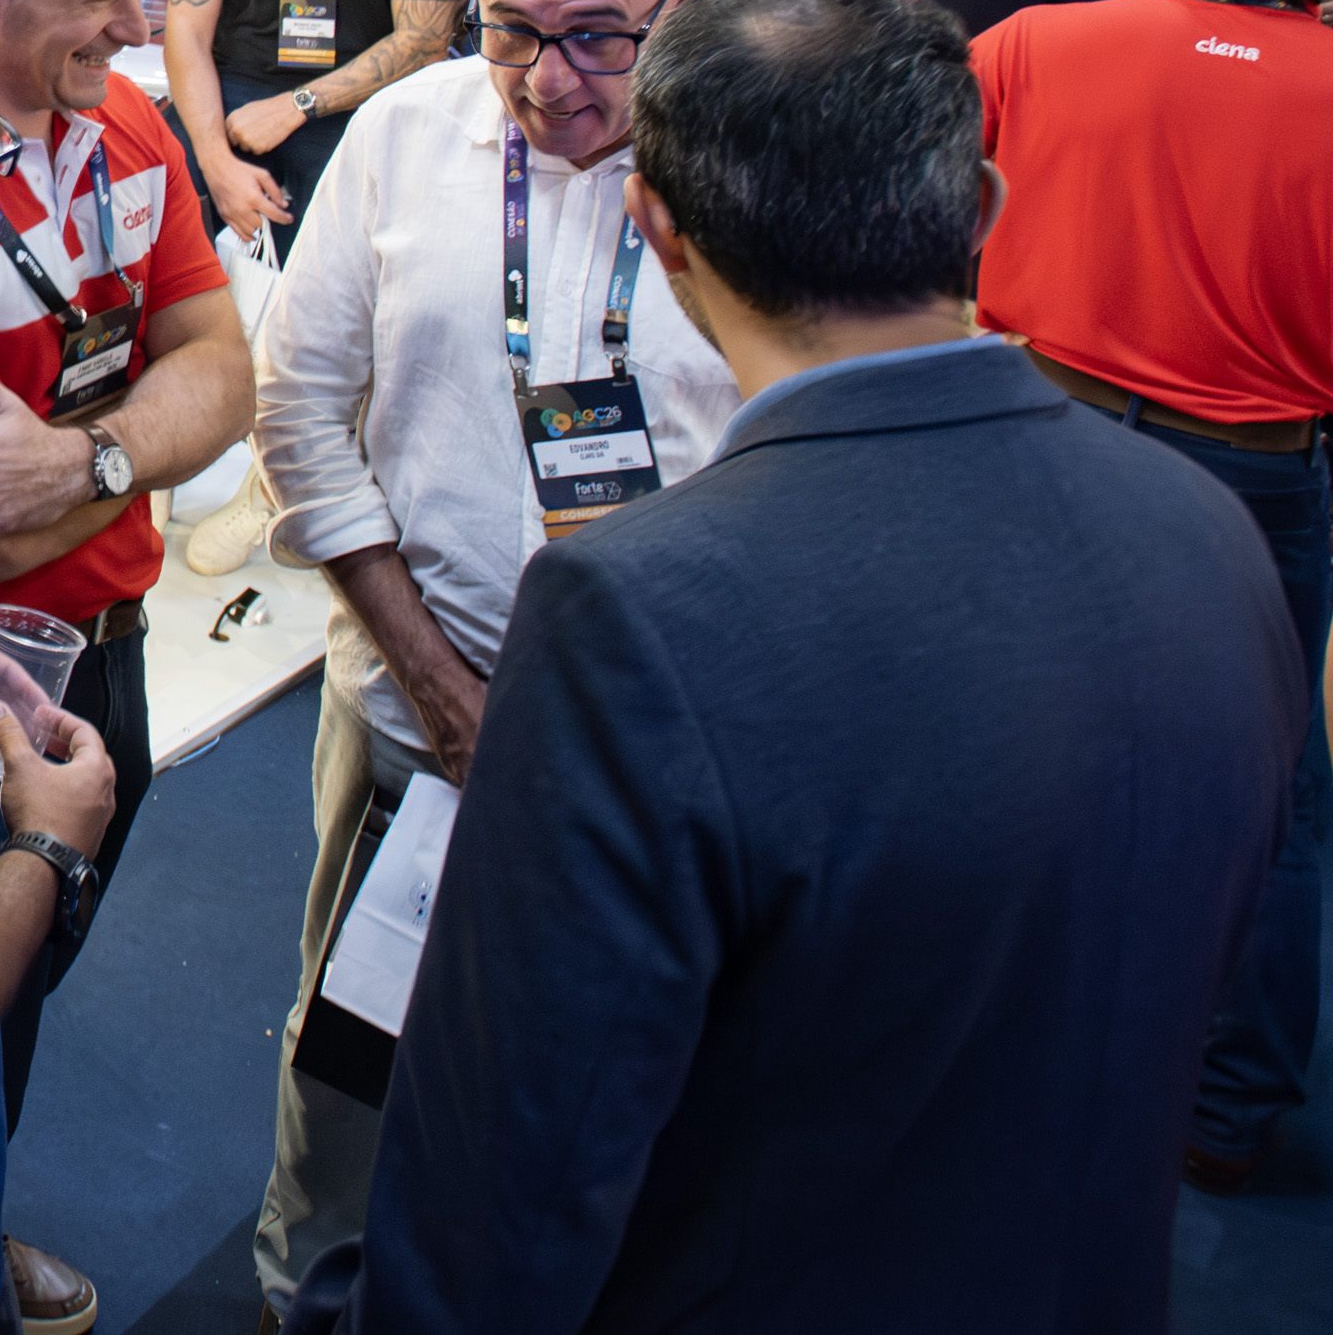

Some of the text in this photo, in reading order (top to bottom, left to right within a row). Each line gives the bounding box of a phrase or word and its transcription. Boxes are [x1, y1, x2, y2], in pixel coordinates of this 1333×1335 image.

[1195, 36, 1261, 62] ciena
[573, 406, 622, 423] AGC26
[575, 481, 604, 496] forte
